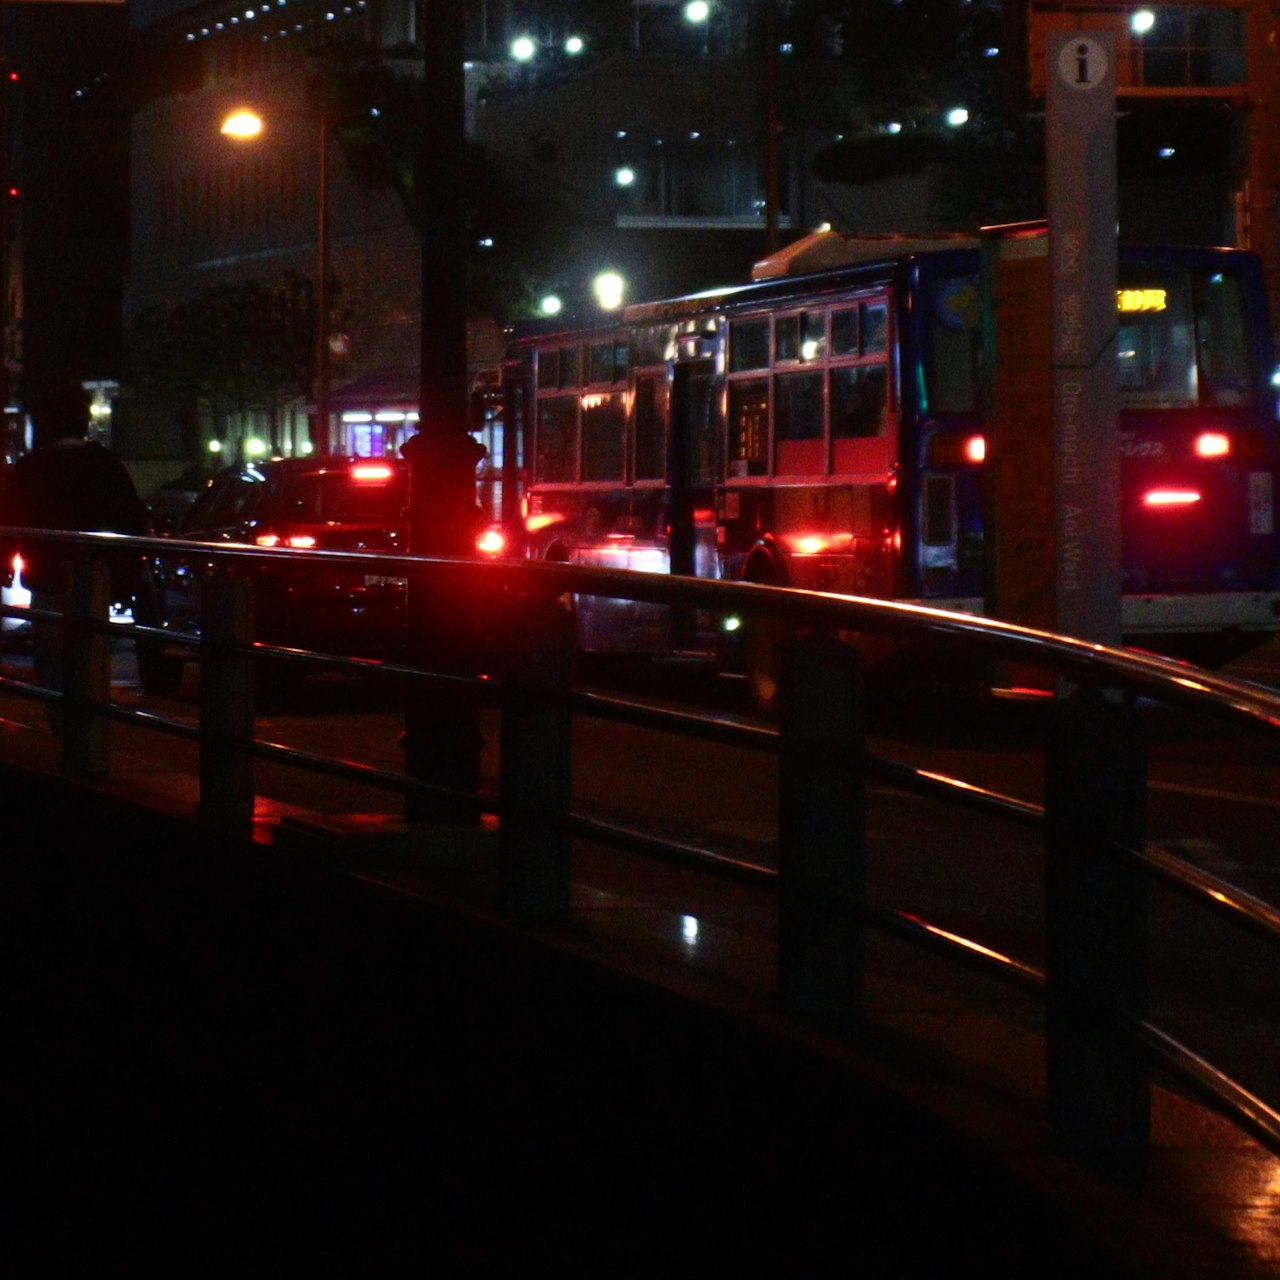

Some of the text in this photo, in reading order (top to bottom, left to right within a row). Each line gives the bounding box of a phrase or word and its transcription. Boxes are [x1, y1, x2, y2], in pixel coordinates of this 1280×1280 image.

[1062, 383, 1082, 484] Ote-machi
[1063, 505, 1082, 590] Aoi Ward
